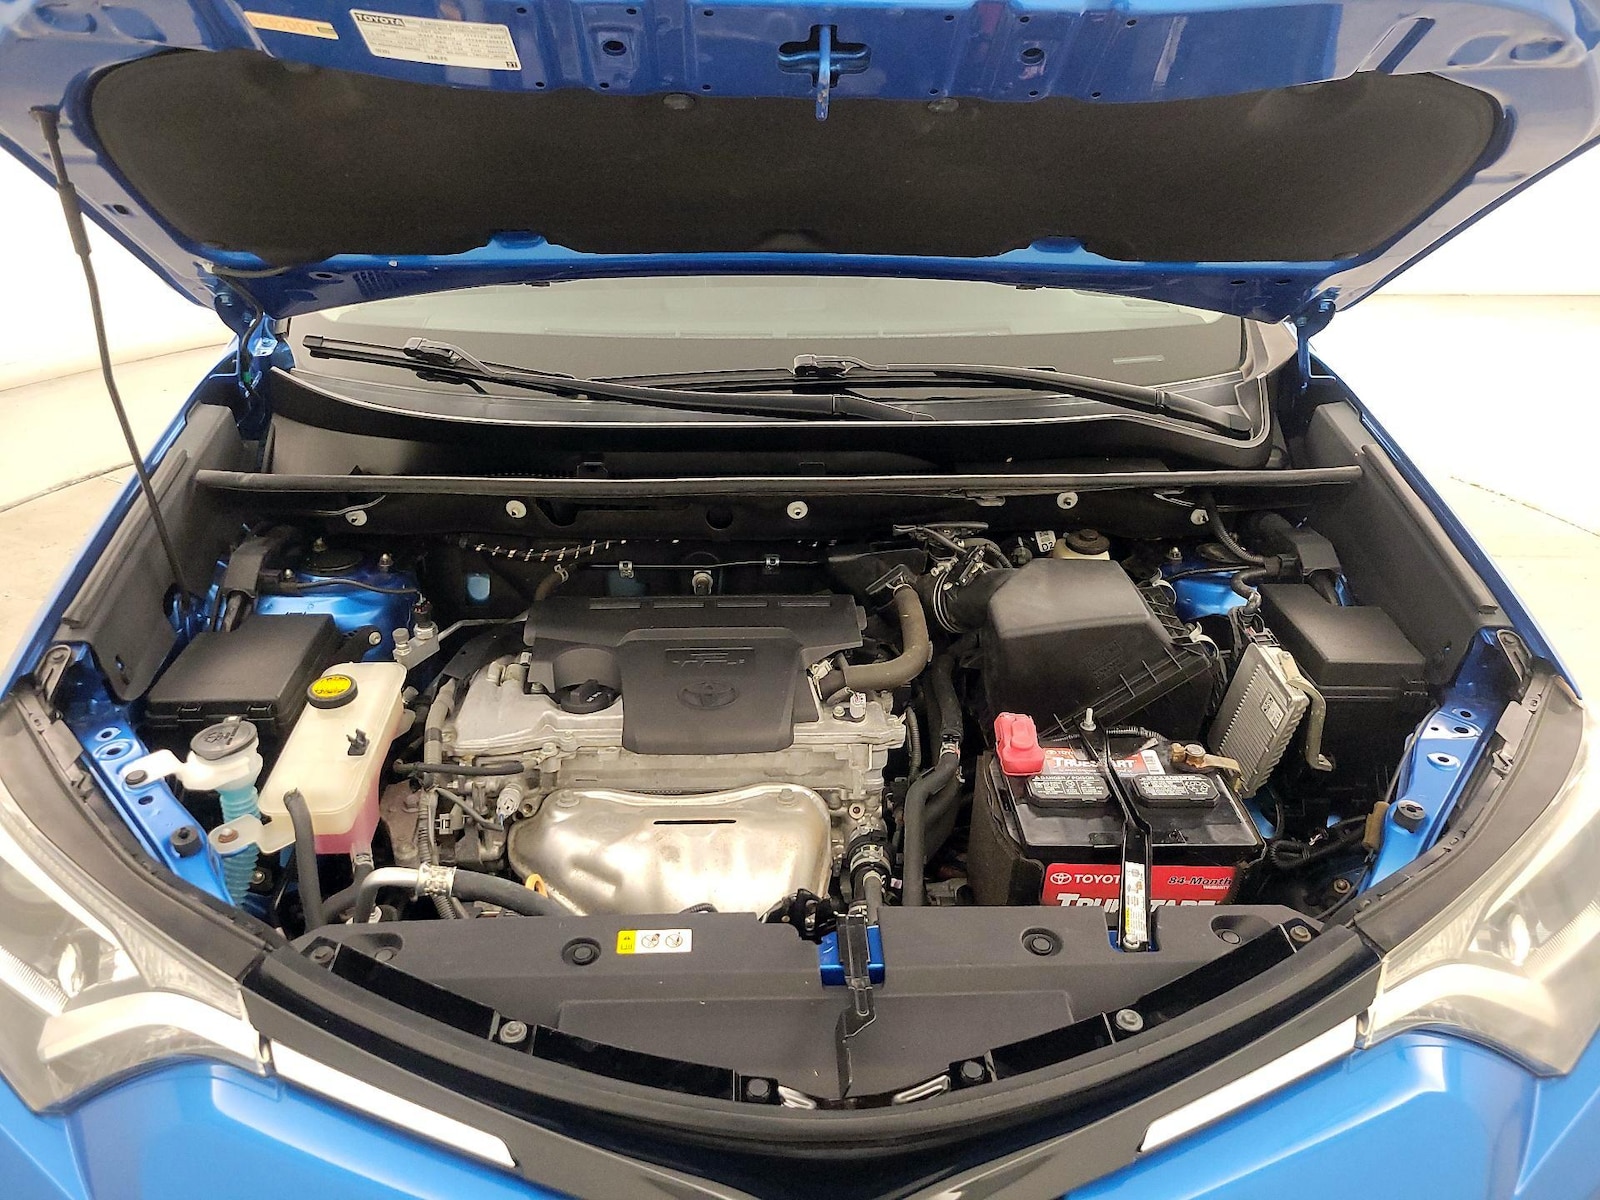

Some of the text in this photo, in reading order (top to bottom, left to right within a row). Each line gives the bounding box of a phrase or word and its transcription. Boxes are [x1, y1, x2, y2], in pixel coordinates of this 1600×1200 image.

[356, 14, 404, 26] TOYOTA
[1053, 757, 1134, 768] TRUESART
[1074, 874, 1120, 885] TOYOT
